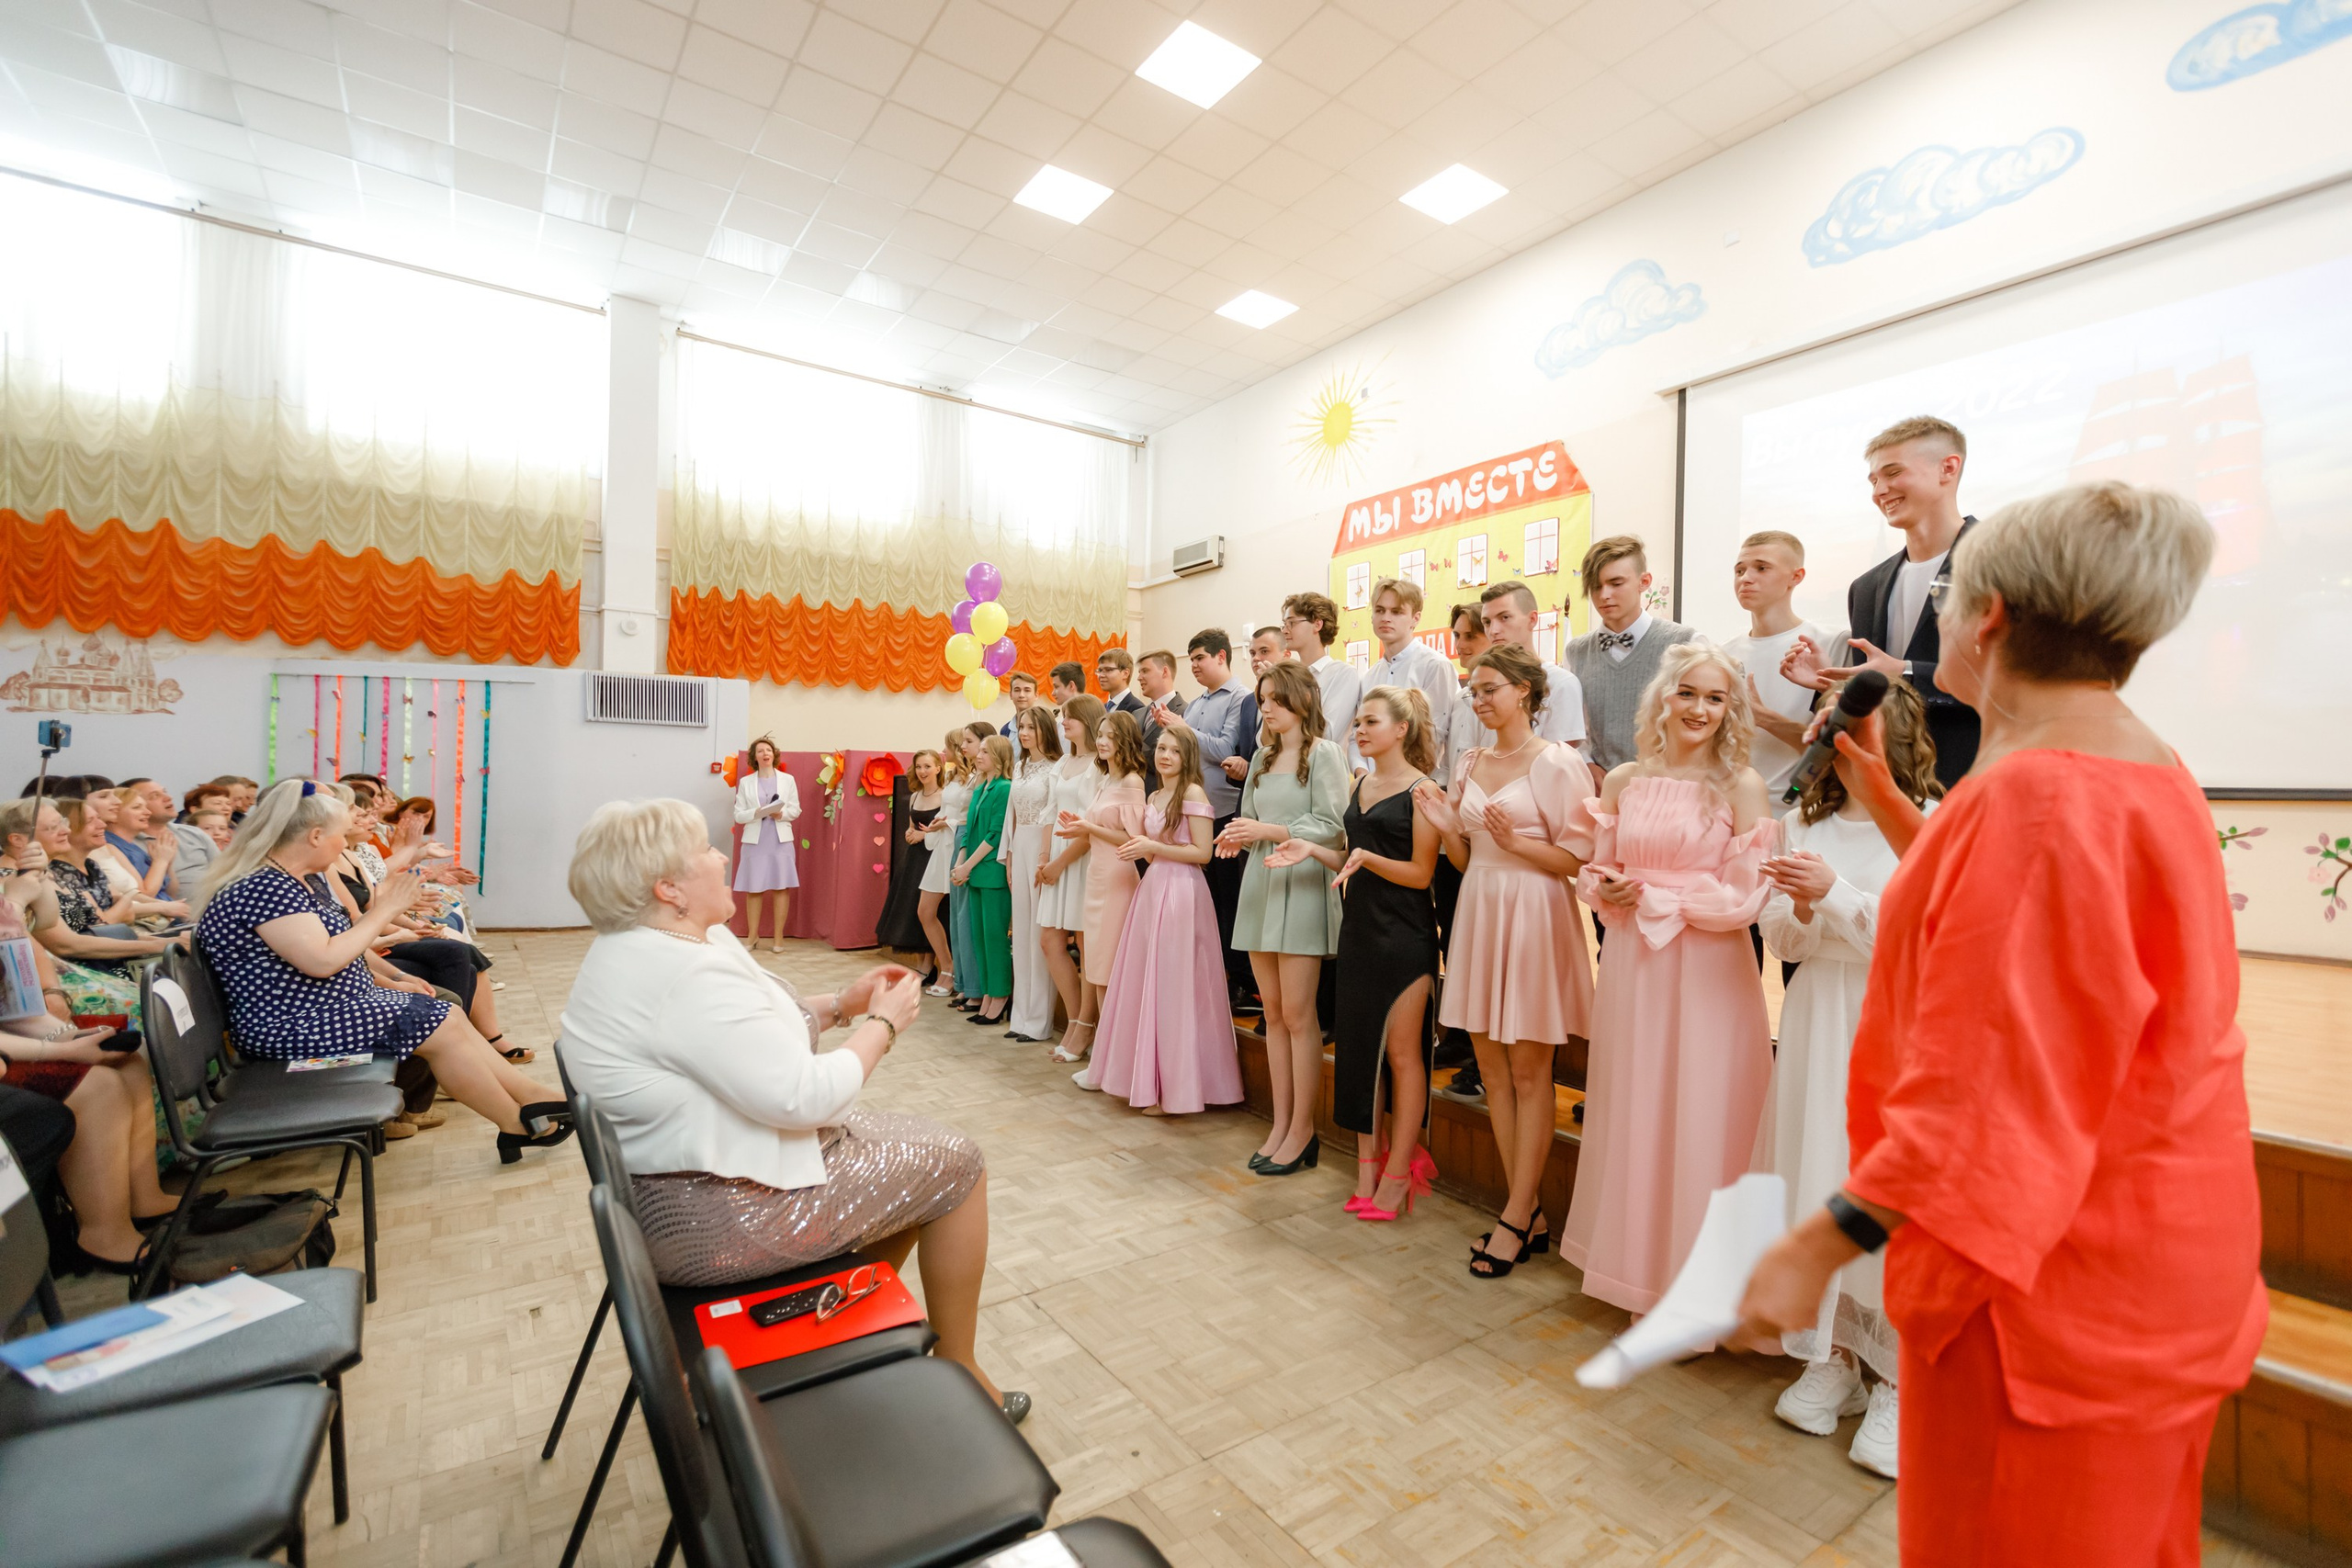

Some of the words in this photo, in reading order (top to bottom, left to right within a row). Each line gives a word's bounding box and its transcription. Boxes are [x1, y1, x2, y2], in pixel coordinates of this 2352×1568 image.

[1937, 362, 2071, 422] 2022
[1348, 496, 1401, 543] МЫ
[1410, 450, 1558, 525] ВМЕСТЕ
